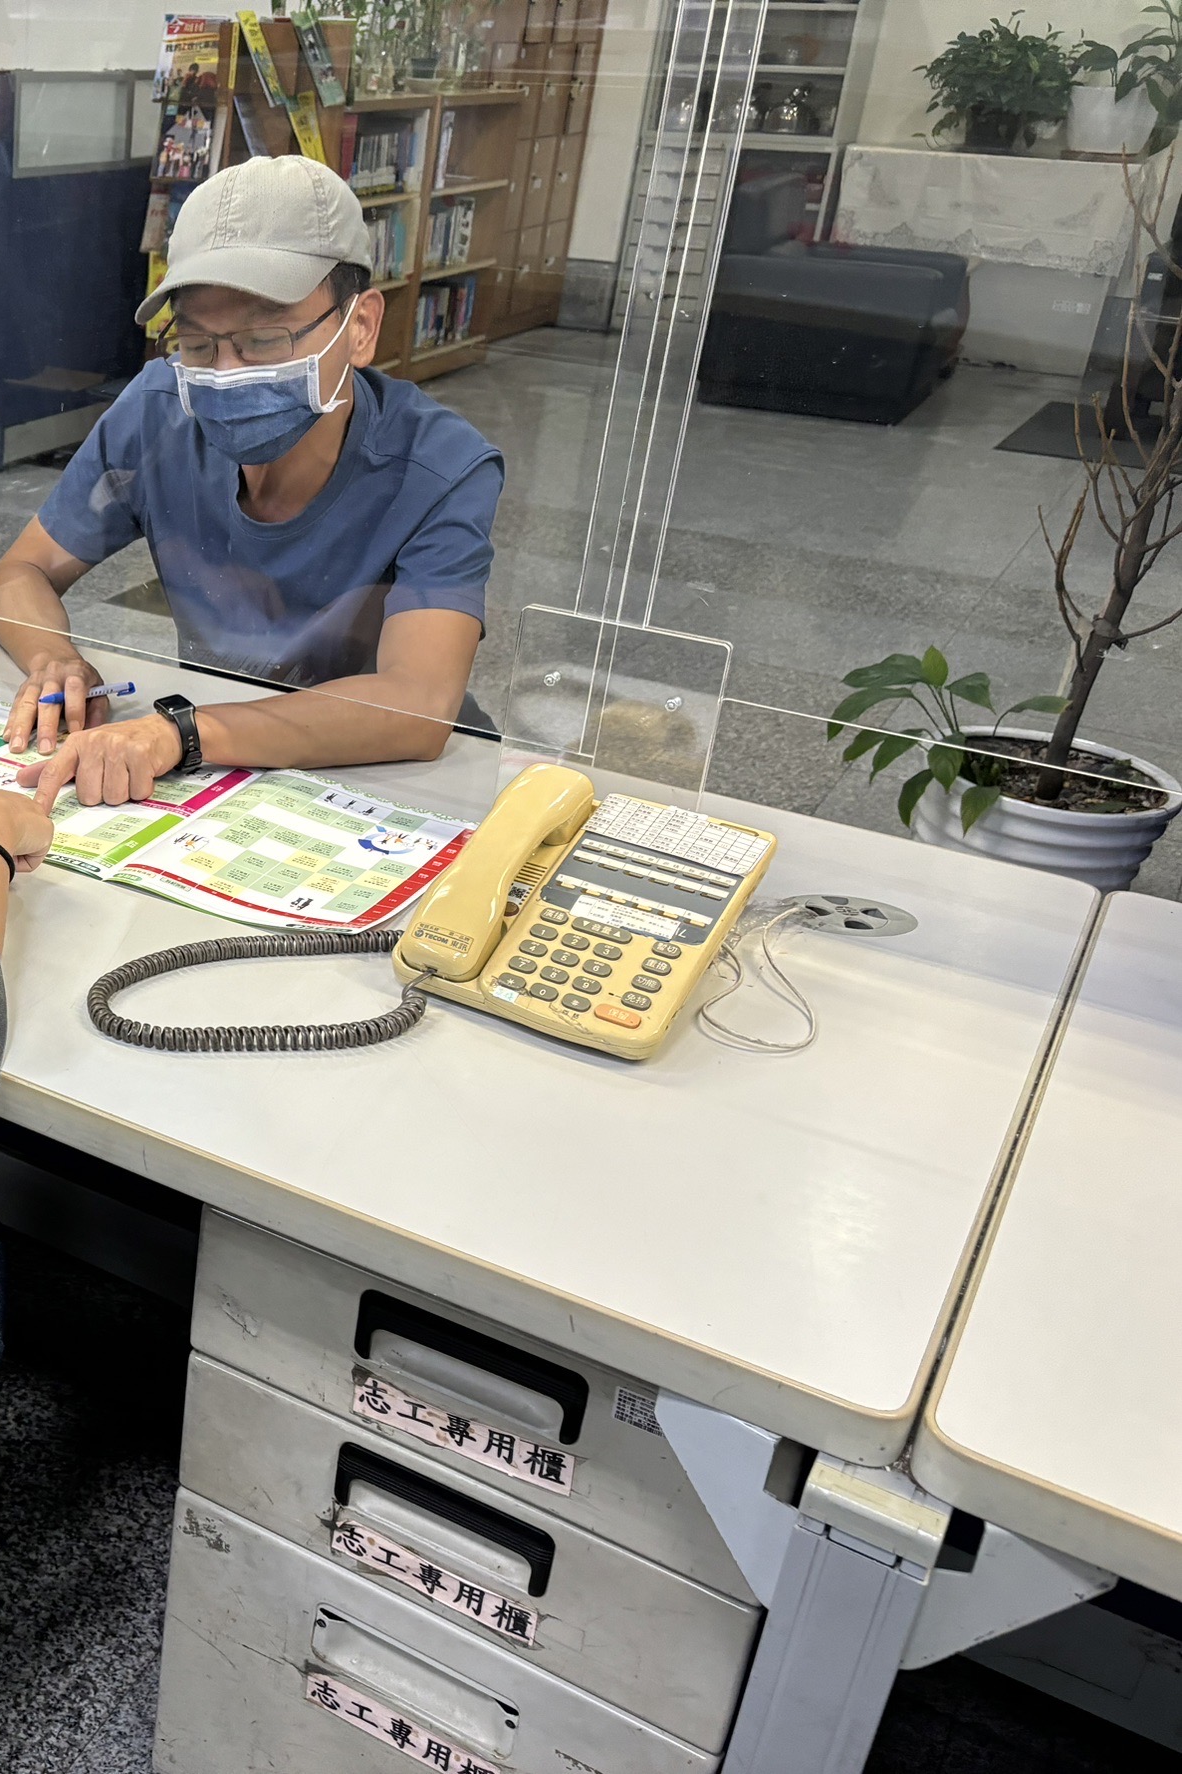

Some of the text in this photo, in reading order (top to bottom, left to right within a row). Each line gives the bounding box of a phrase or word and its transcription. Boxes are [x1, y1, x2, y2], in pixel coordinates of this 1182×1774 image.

[424, 932, 449, 944] TECOM
[636, 975, 659, 989] 功能
[358, 1380, 566, 1486] 志工專用櫃
[335, 1527, 533, 1641] 志工專用櫃
